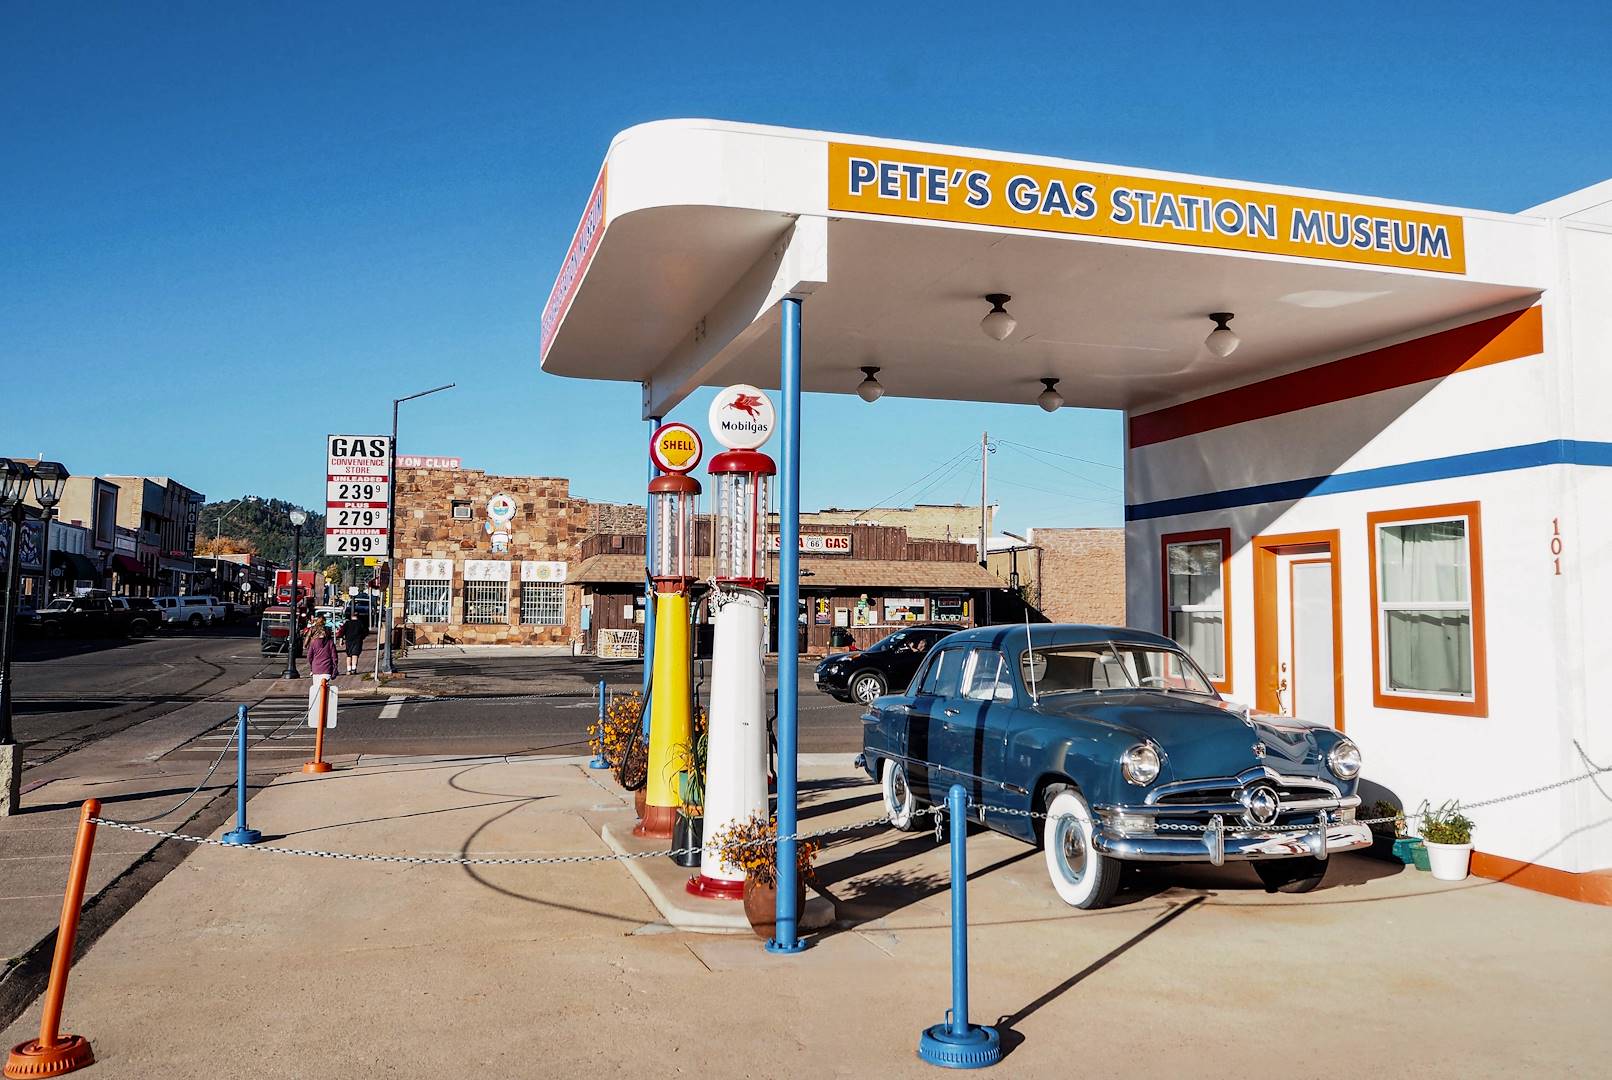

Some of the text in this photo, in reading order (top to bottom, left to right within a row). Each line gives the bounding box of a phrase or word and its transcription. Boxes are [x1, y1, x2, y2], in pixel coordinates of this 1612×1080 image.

[850, 158, 1452, 258] PETE'S GAS STATION MUSEUM
[722, 421, 768, 433] Mobilgas
[332, 438, 385, 457] GAS
[663, 440, 693, 451] SHELL
[331, 458, 385, 467] CONVENIENCE
[426, 458, 458, 468] CLUB
[345, 466, 370, 474] STORE
[825, 537, 848, 549] GAS
